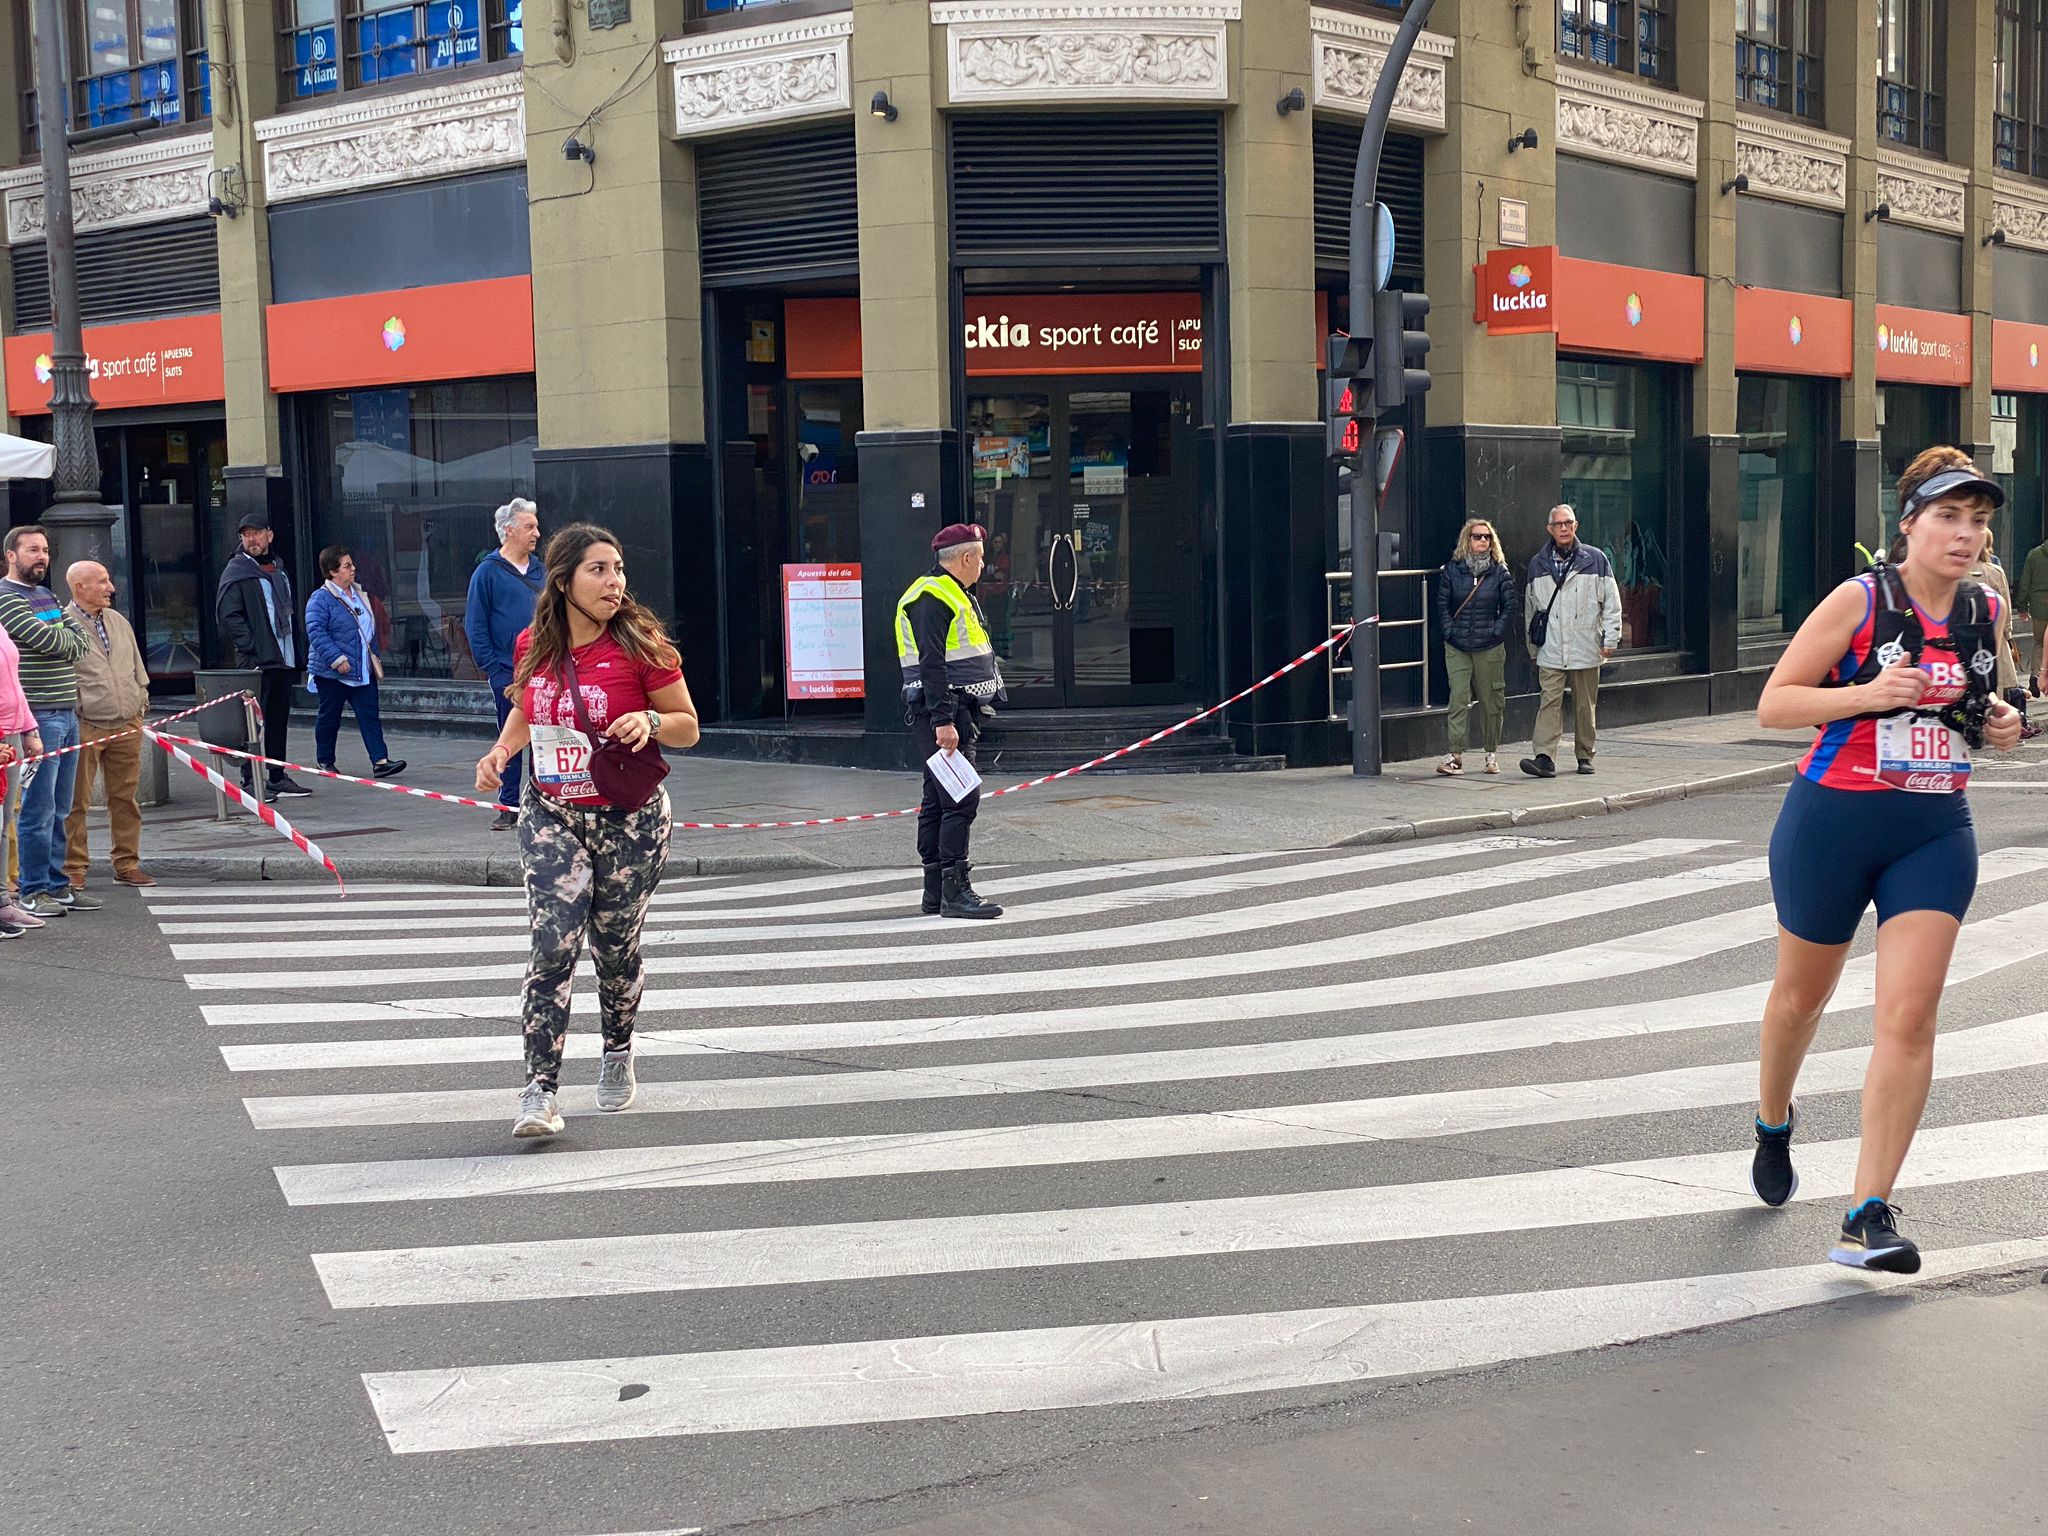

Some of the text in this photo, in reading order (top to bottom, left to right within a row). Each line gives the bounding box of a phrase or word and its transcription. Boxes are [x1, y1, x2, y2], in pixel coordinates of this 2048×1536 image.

[437, 36, 477, 58] Allanz
[303, 66, 337, 86] Alianz
[150, 99, 179, 117] Alianz
[1493, 290, 1547, 312] luckia
[1039, 323, 1102, 351] sport
[1110, 320, 1159, 350] café
[1890, 328, 1918, 355] luckia
[1920, 340, 1937, 358] sport
[164, 347, 193, 359] APUESTAS
[102, 356, 131, 381] sport
[134, 351, 157, 378] café
[165, 366, 183, 377] SLOTS
[797, 569, 852, 578] Apuesta del día
[809, 685, 861, 694] luckia apuestas
[1911, 726, 1950, 760] 618
